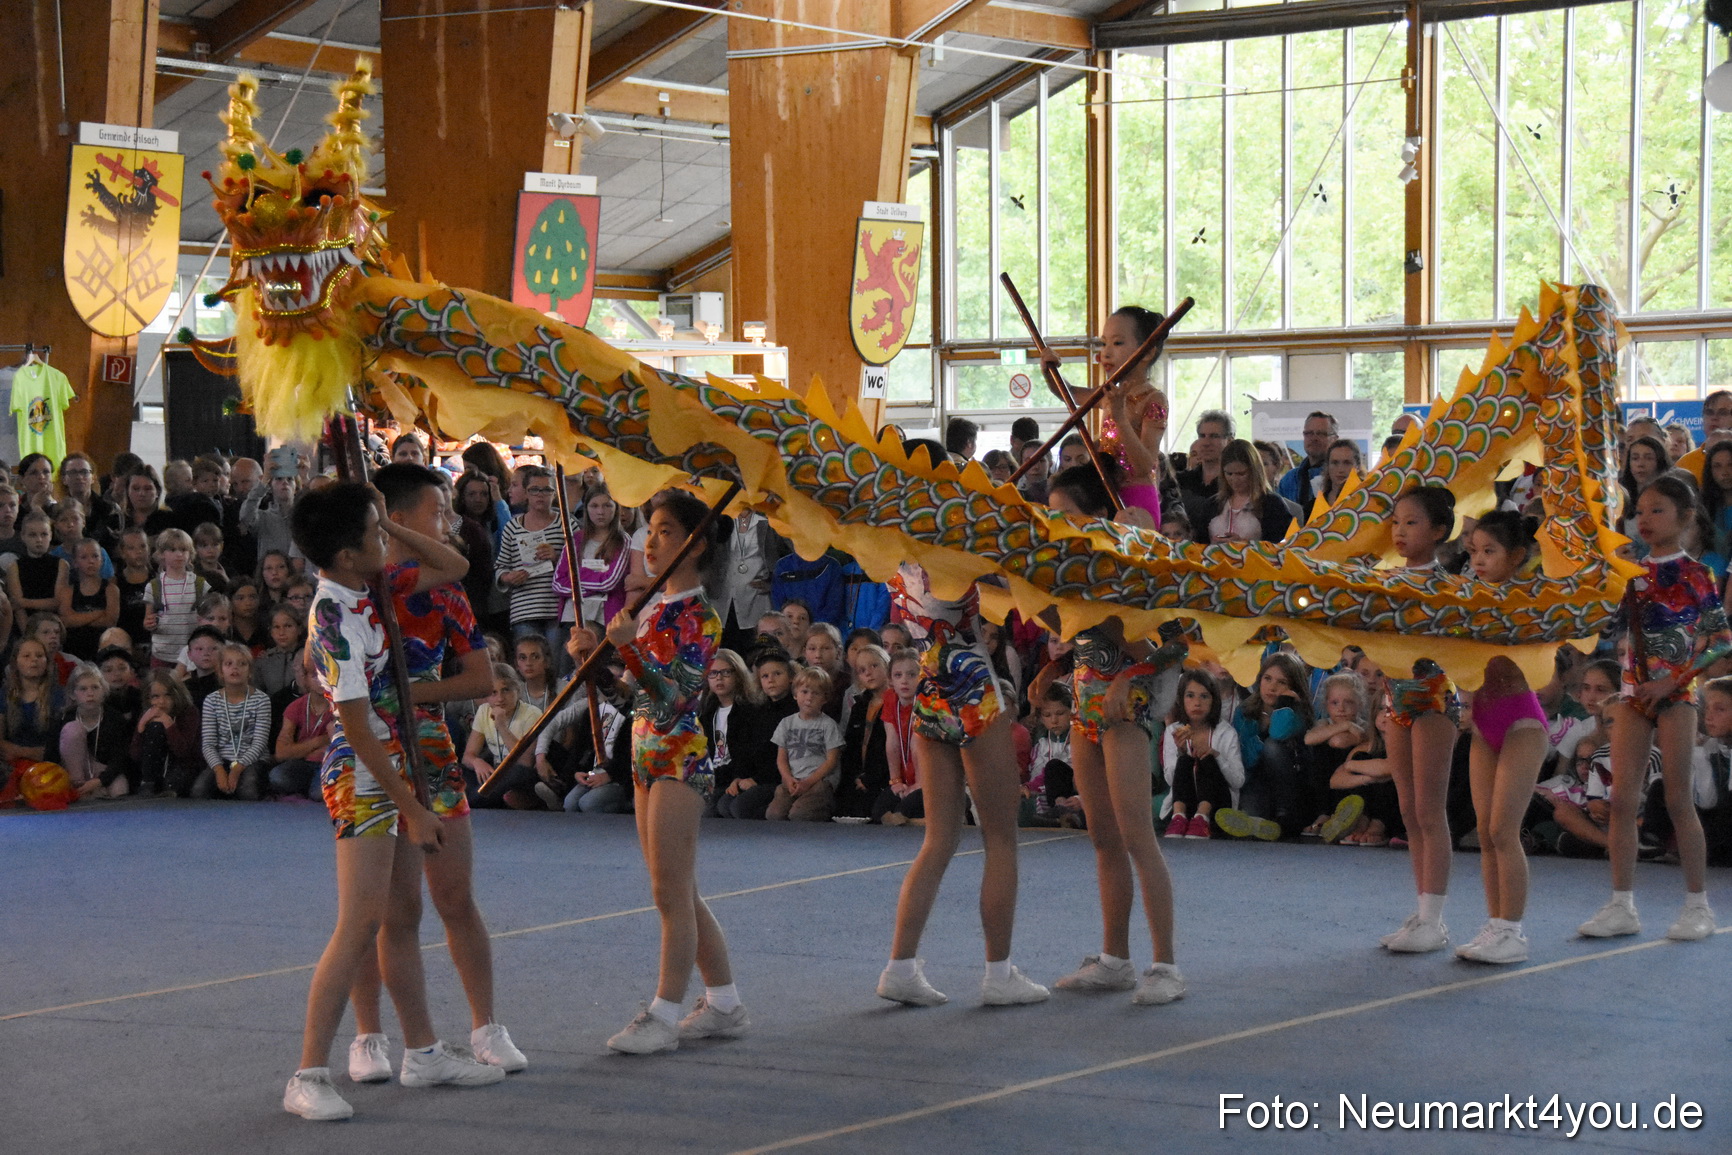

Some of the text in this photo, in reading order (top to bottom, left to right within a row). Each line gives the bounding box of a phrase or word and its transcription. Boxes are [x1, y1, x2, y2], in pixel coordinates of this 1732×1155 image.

[98, 128, 131, 143] Gemeinde
[876, 205, 889, 215] Stadt
[867, 375, 884, 389] WC
